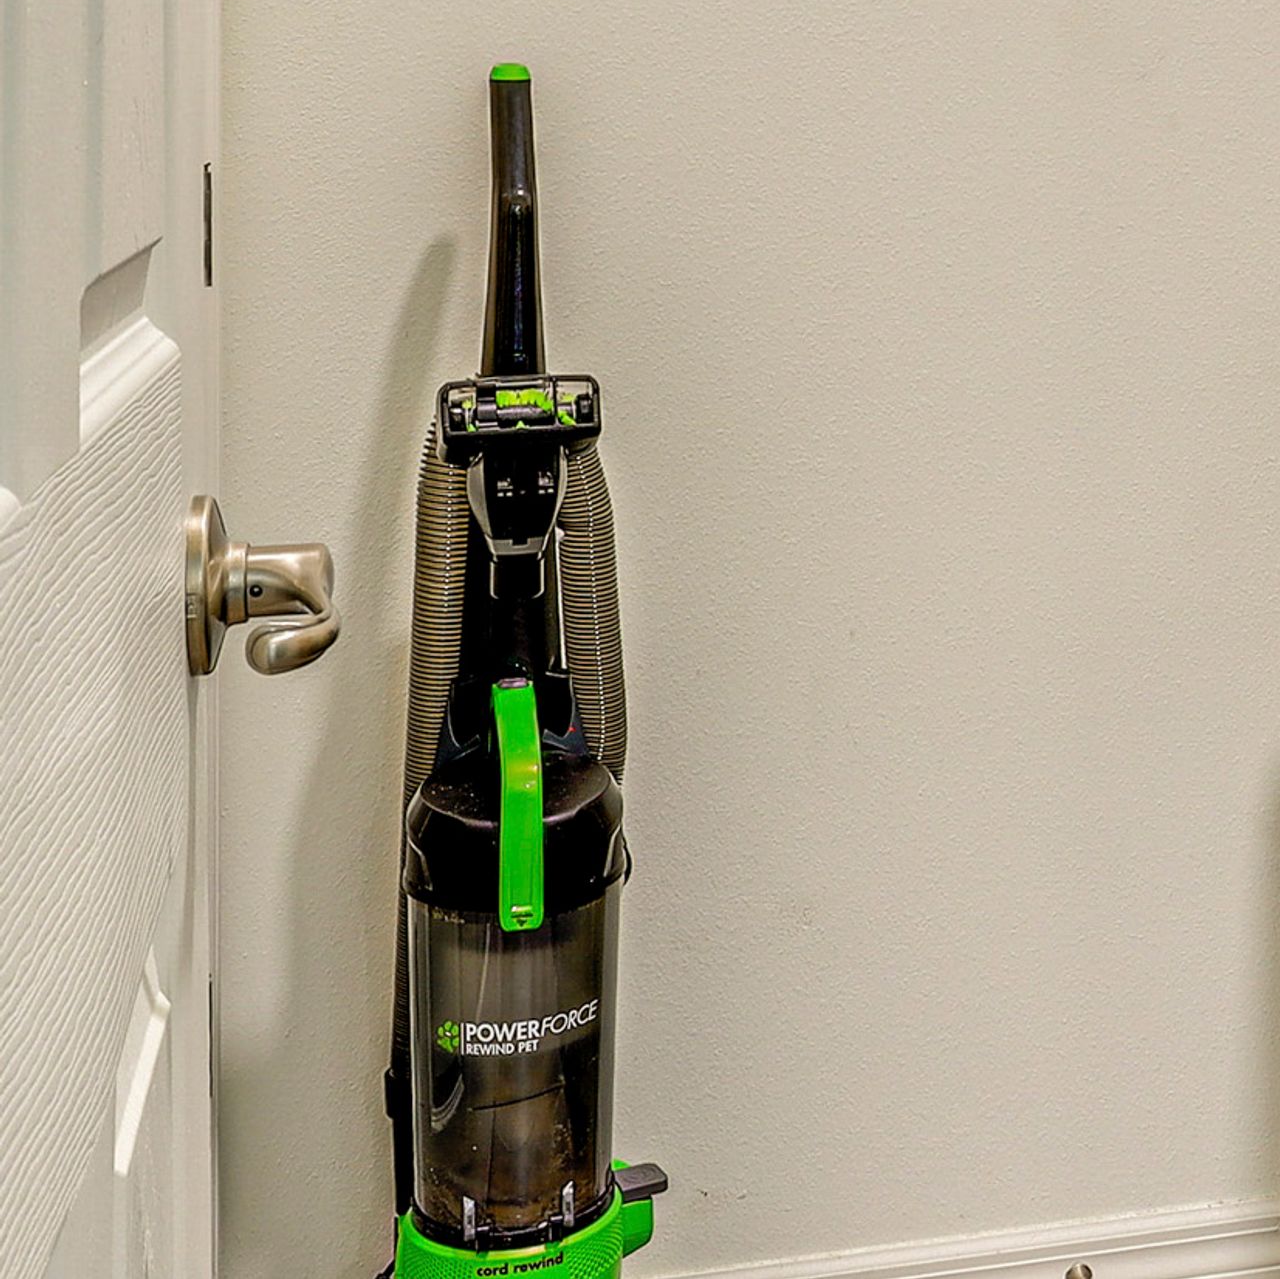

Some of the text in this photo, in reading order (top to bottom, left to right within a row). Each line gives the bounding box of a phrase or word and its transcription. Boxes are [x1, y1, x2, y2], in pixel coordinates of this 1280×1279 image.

[466, 999, 599, 1042] POWERFORCE
[466, 1040, 538, 1056] REWIND PET
[477, 1251, 564, 1276] cord rewind
